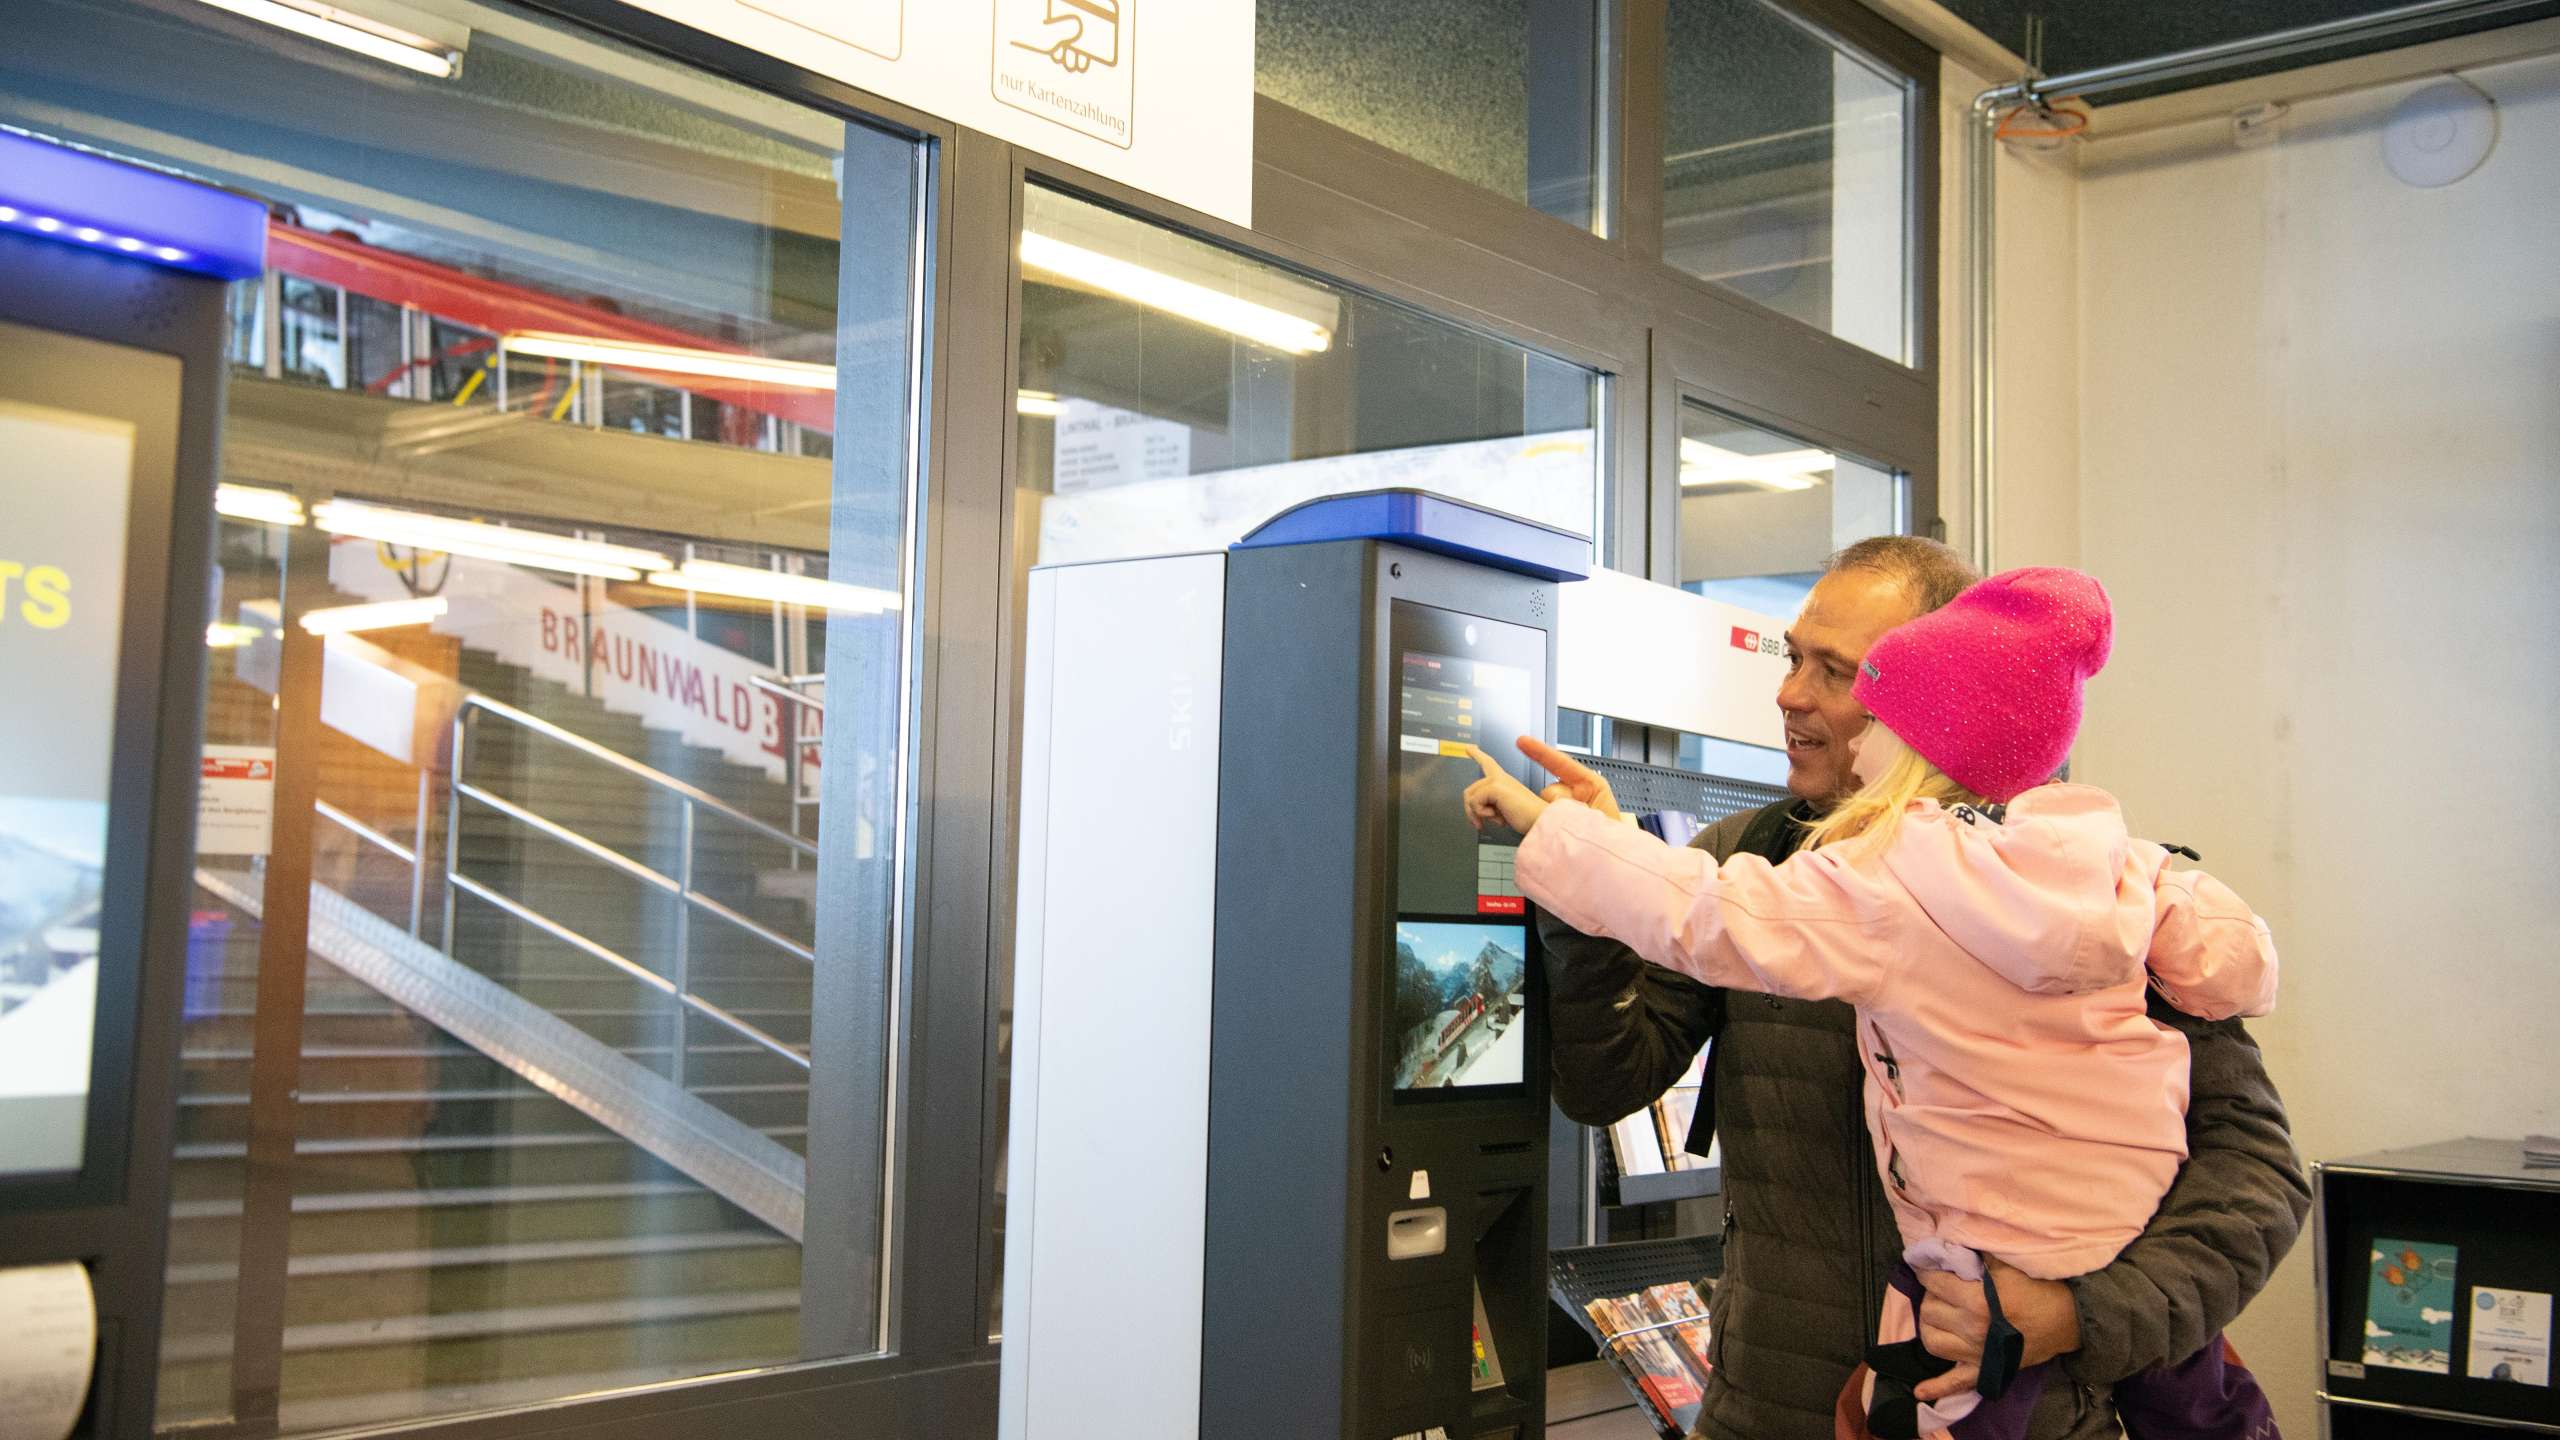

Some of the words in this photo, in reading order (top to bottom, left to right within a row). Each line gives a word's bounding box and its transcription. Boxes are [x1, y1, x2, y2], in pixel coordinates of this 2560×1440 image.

[1000, 73, 1024, 92] nur
[1028, 80, 1125, 136] Kartenzahlung
[1761, 637, 1780, 656] SBB
